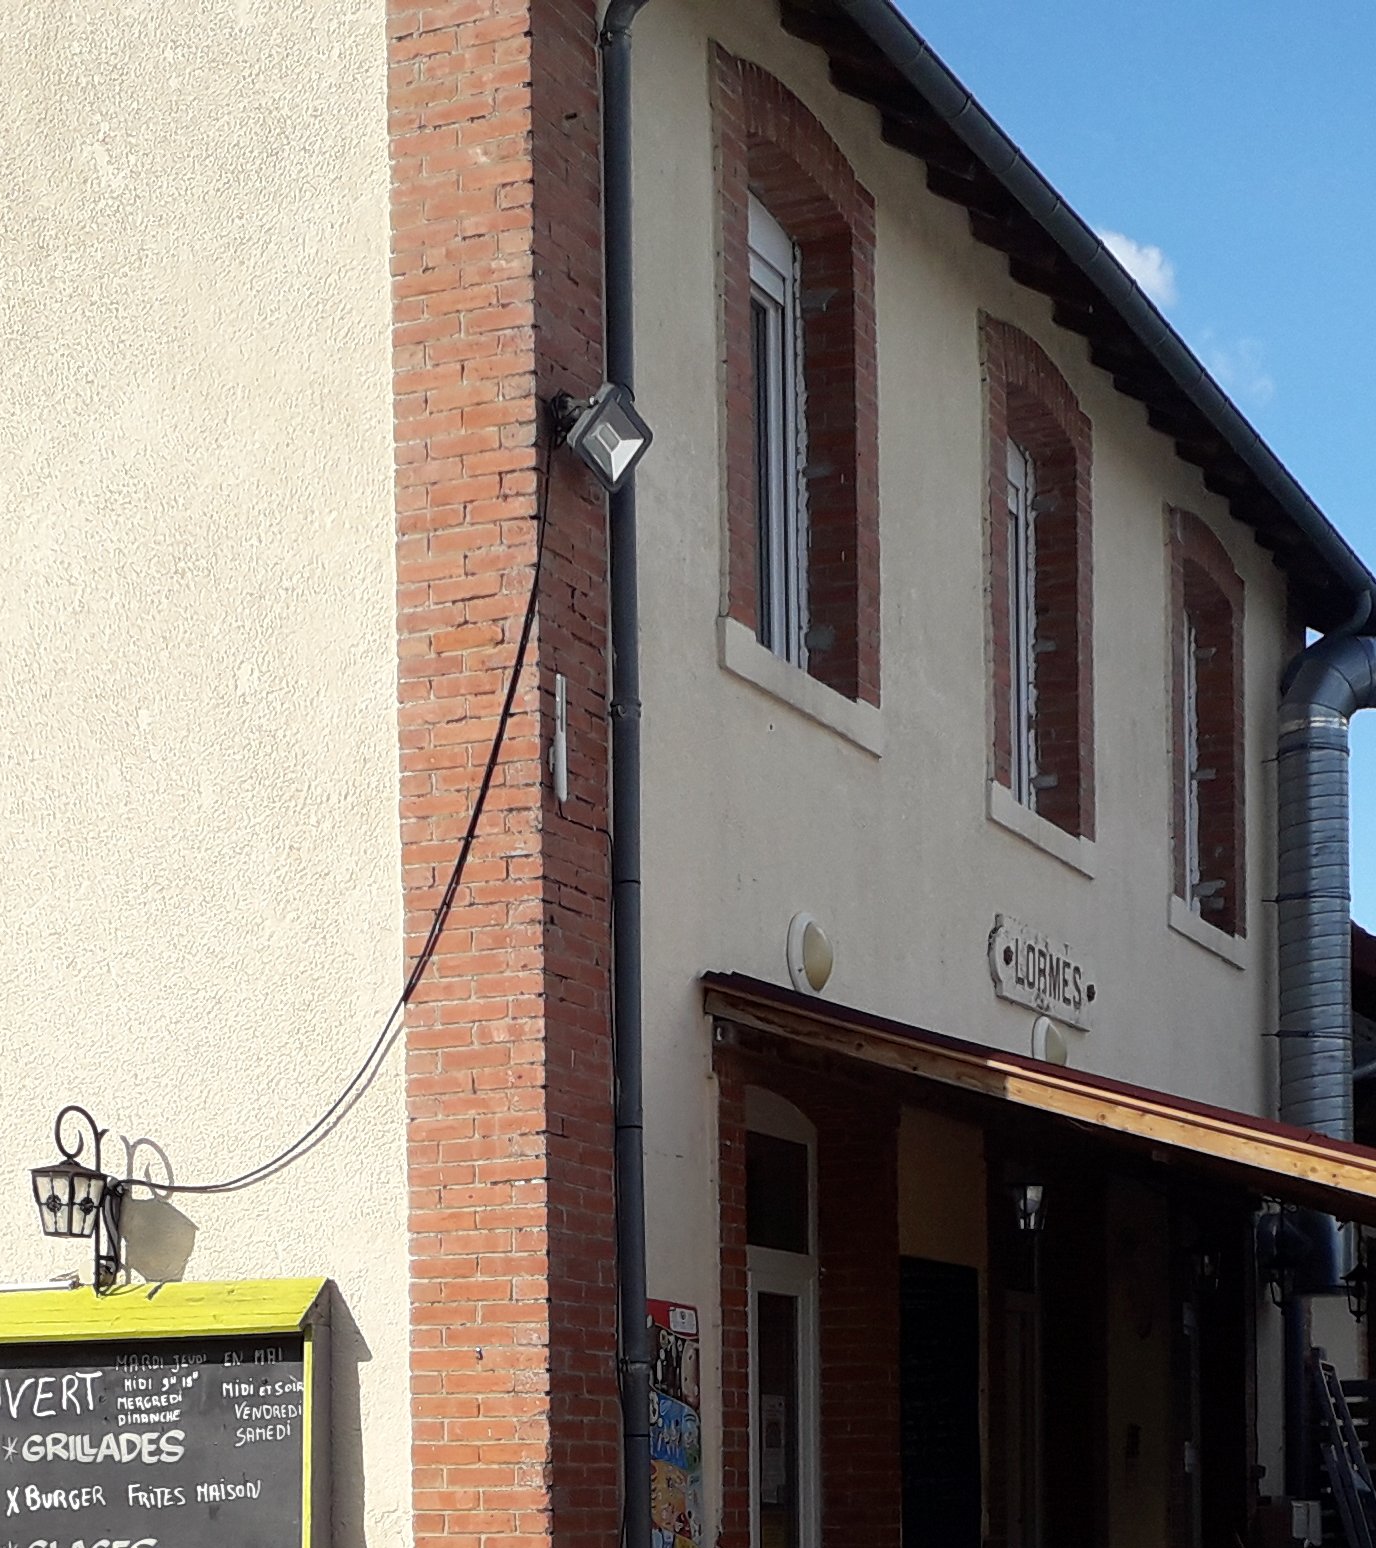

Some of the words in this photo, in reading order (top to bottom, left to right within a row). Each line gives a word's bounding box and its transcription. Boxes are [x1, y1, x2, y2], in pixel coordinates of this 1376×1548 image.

[115, 1354, 164, 1373] MARDI
[171, 1354, 207, 1373] JEUDI
[224, 1351, 244, 1367] EN
[254, 1347, 283, 1365] MAI
[123, 1375, 153, 1392] MIDI
[222, 1378, 255, 1398] MIDI
[117, 1389, 183, 1410] MERCREDI
[117, 1409, 181, 1427] DIMANCHE
[234, 1400, 302, 1421] VENDREDI
[234, 1420, 291, 1447] SAMEDI
[21, 1429, 186, 1464] GRILLADES
[24, 1484, 107, 1511] BURGER
[127, 1483, 187, 1509] FRITES
[196, 1479, 262, 1503] MAISON
